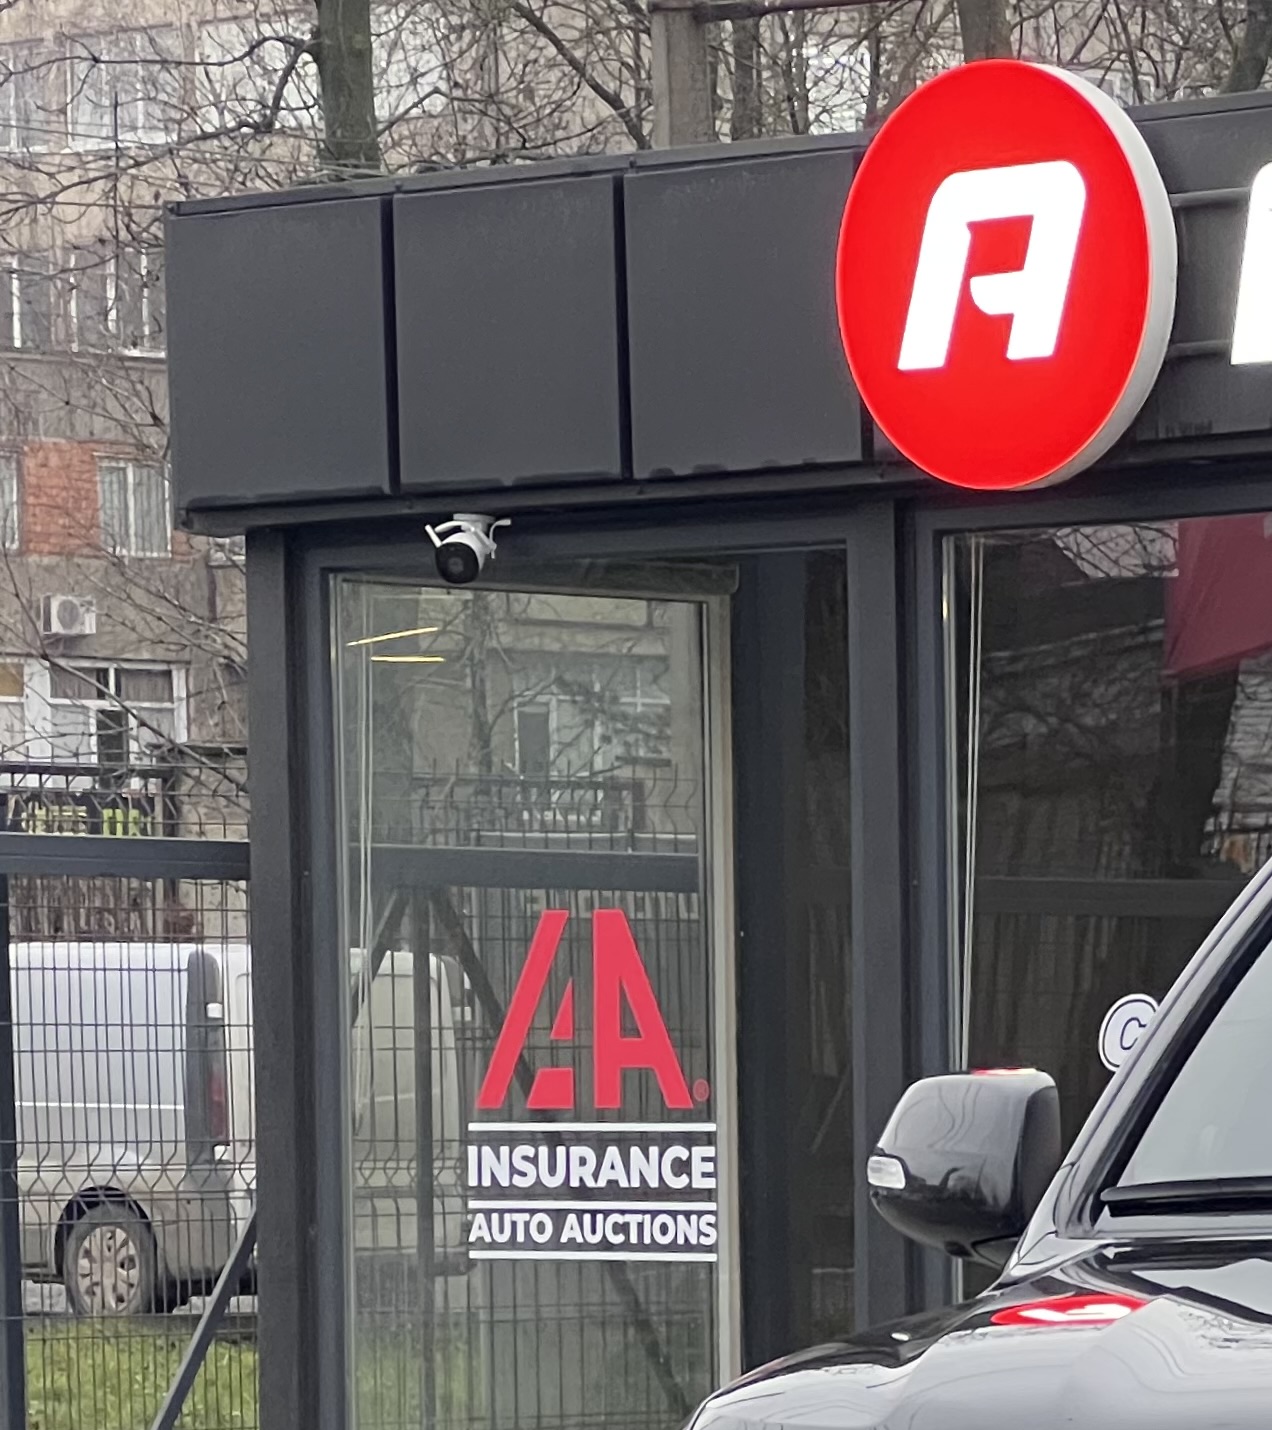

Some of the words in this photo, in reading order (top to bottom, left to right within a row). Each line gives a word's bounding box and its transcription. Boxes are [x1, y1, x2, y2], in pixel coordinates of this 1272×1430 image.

[467, 1145, 717, 1189] INSURANCE
[469, 1212, 553, 1244] AUTO
[560, 1213, 717, 1246] AUCTIONS
